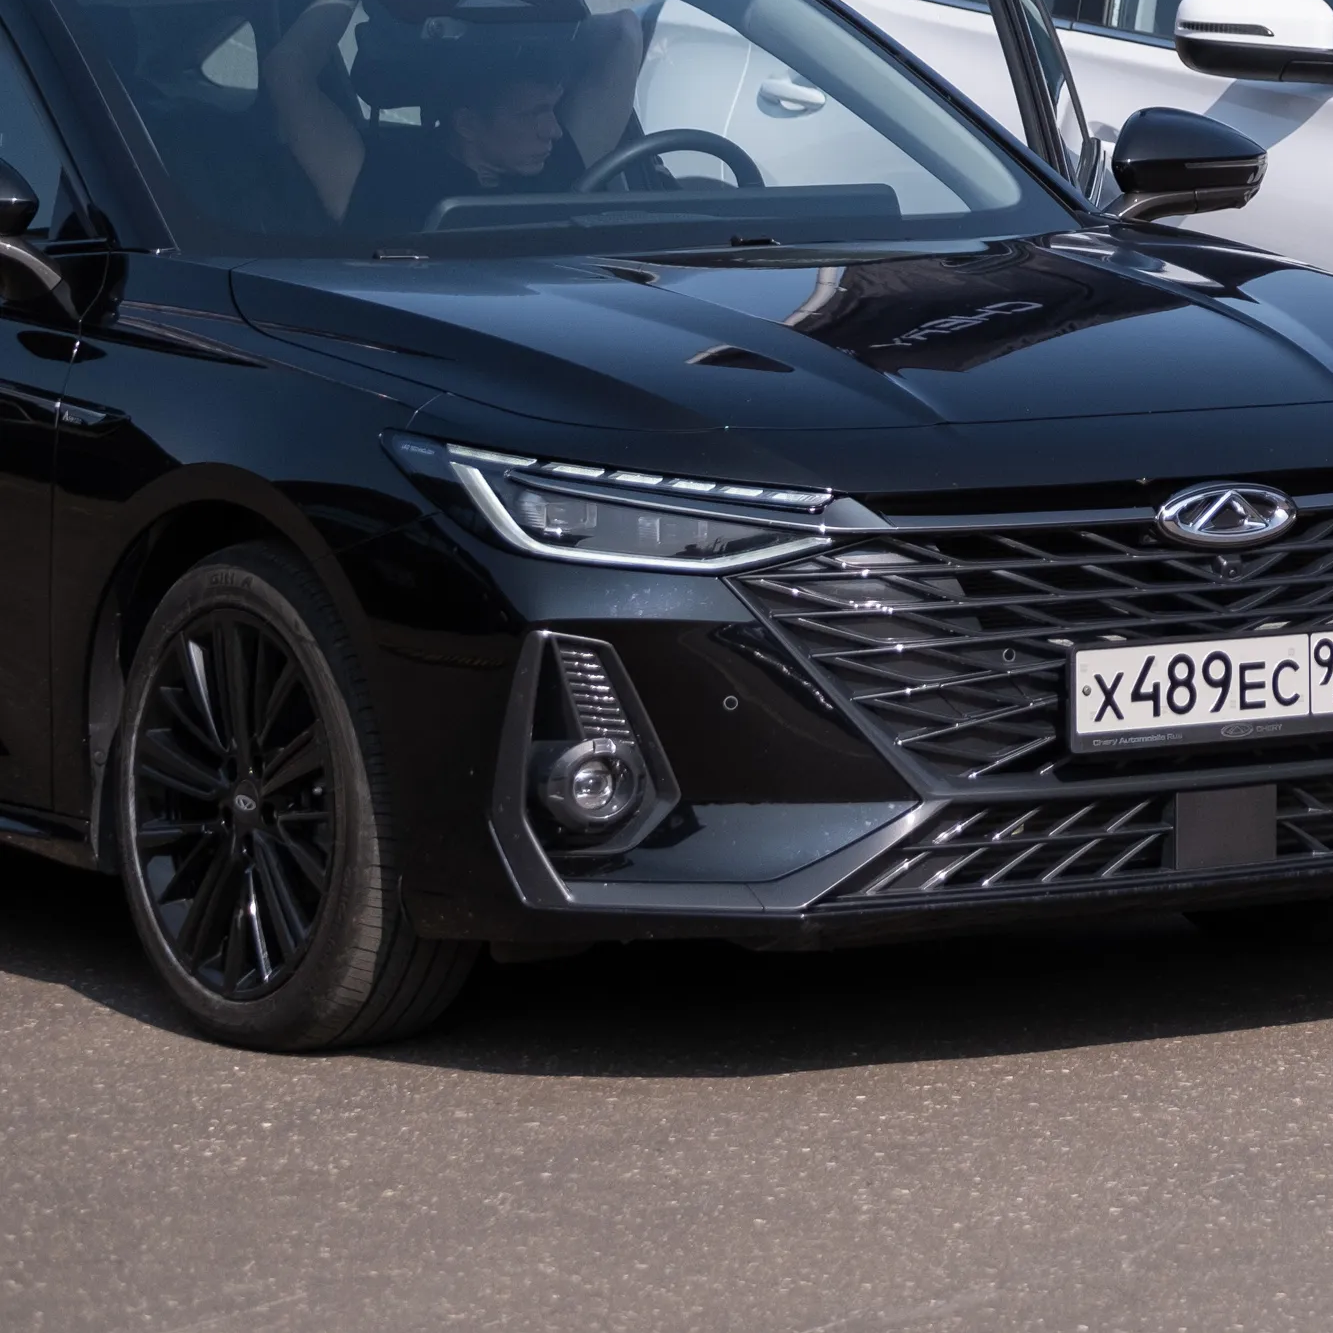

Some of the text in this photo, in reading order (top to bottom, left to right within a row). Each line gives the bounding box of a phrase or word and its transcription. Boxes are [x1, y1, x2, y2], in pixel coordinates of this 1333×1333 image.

[1256, 723, 1283, 733] CHERY
[1092, 737, 1118, 747] Chery
[1118, 733, 1166, 745] Automobile
